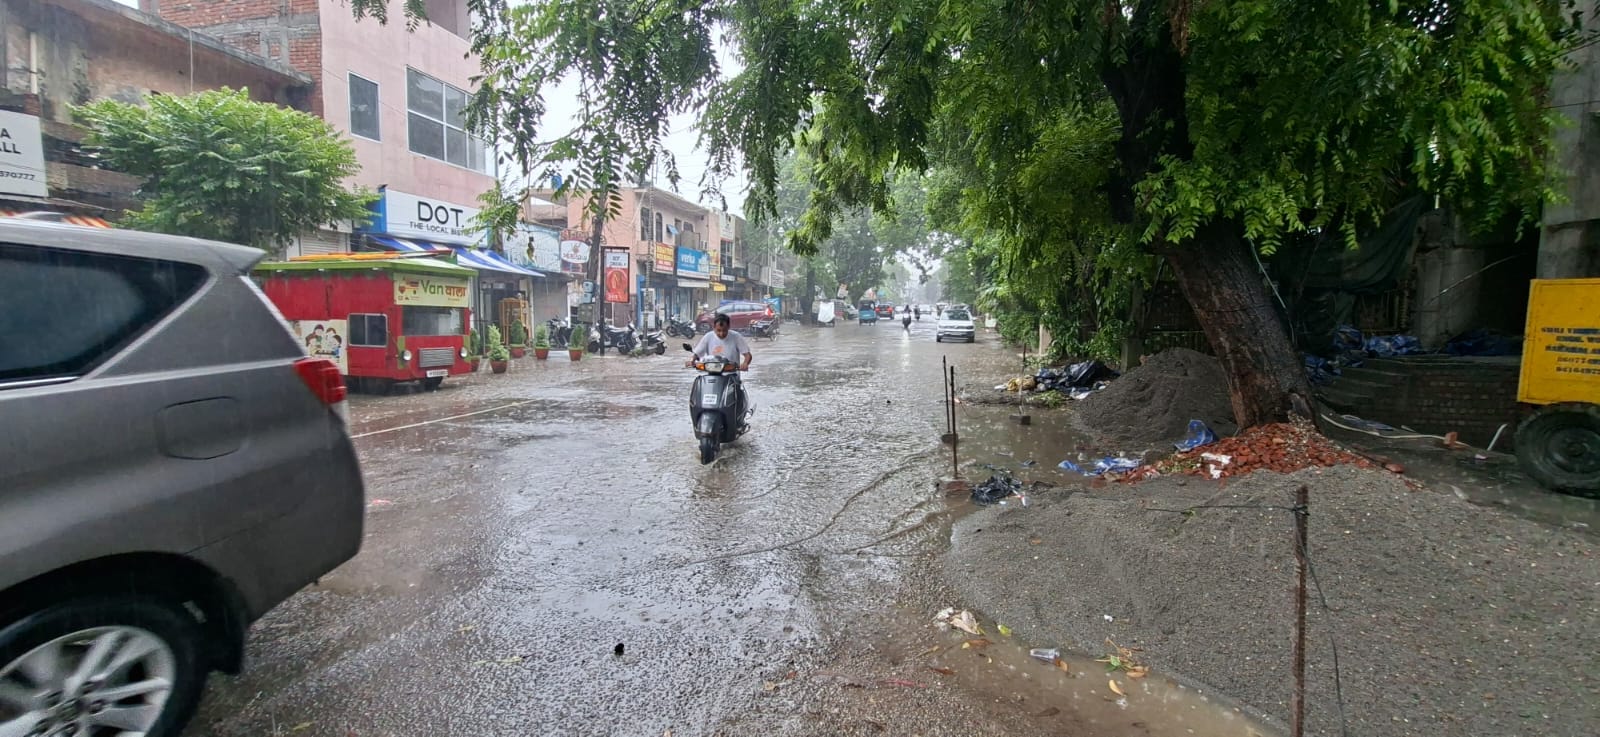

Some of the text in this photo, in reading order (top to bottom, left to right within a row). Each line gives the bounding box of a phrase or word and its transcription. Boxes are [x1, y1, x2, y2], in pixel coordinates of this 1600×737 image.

[0, 142, 21, 155] LL
[418, 201, 465, 228] DOT.
[409, 221, 424, 230] THE
[426, 225, 449, 235] LOCAL
[421, 280, 466, 297] Van वाला
